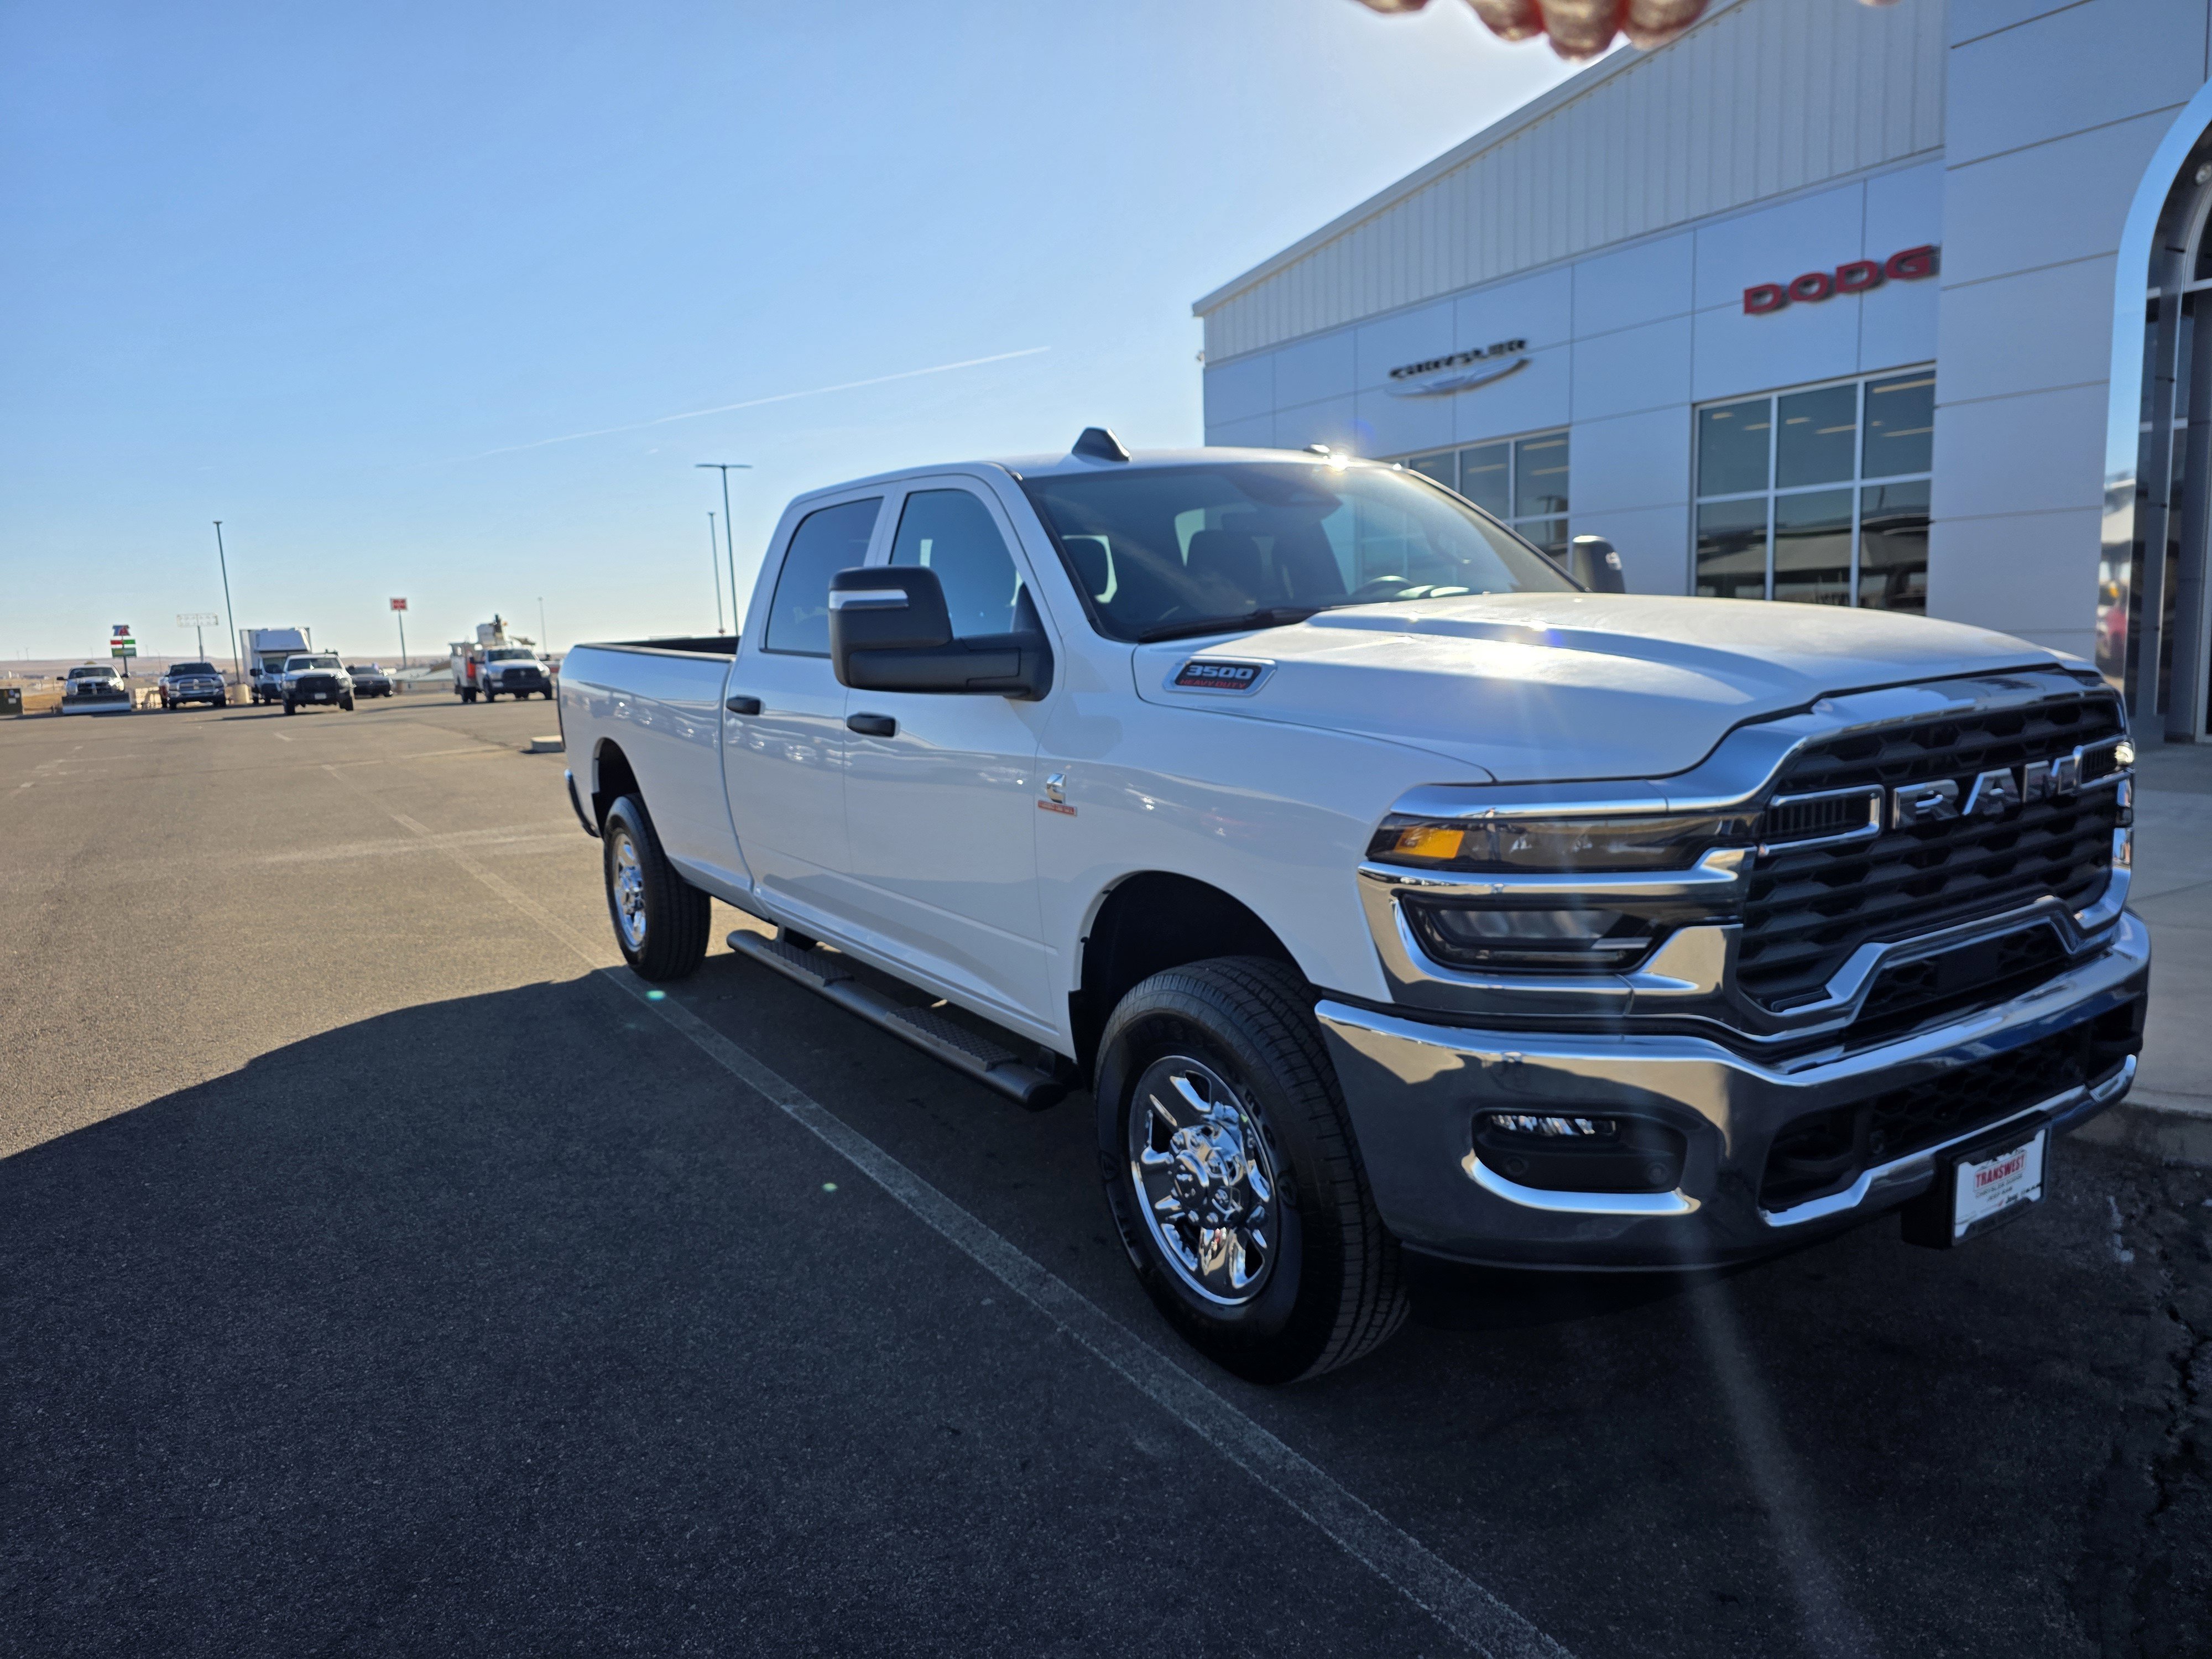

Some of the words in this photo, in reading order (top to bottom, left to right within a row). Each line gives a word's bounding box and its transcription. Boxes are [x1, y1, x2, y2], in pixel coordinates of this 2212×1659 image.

[1743, 243, 1941, 315] DODG
[1186, 665, 1254, 680] 3500
[1891, 754, 2078, 830] RAM
[1975, 1154, 2025, 1188] TRANSWEST
